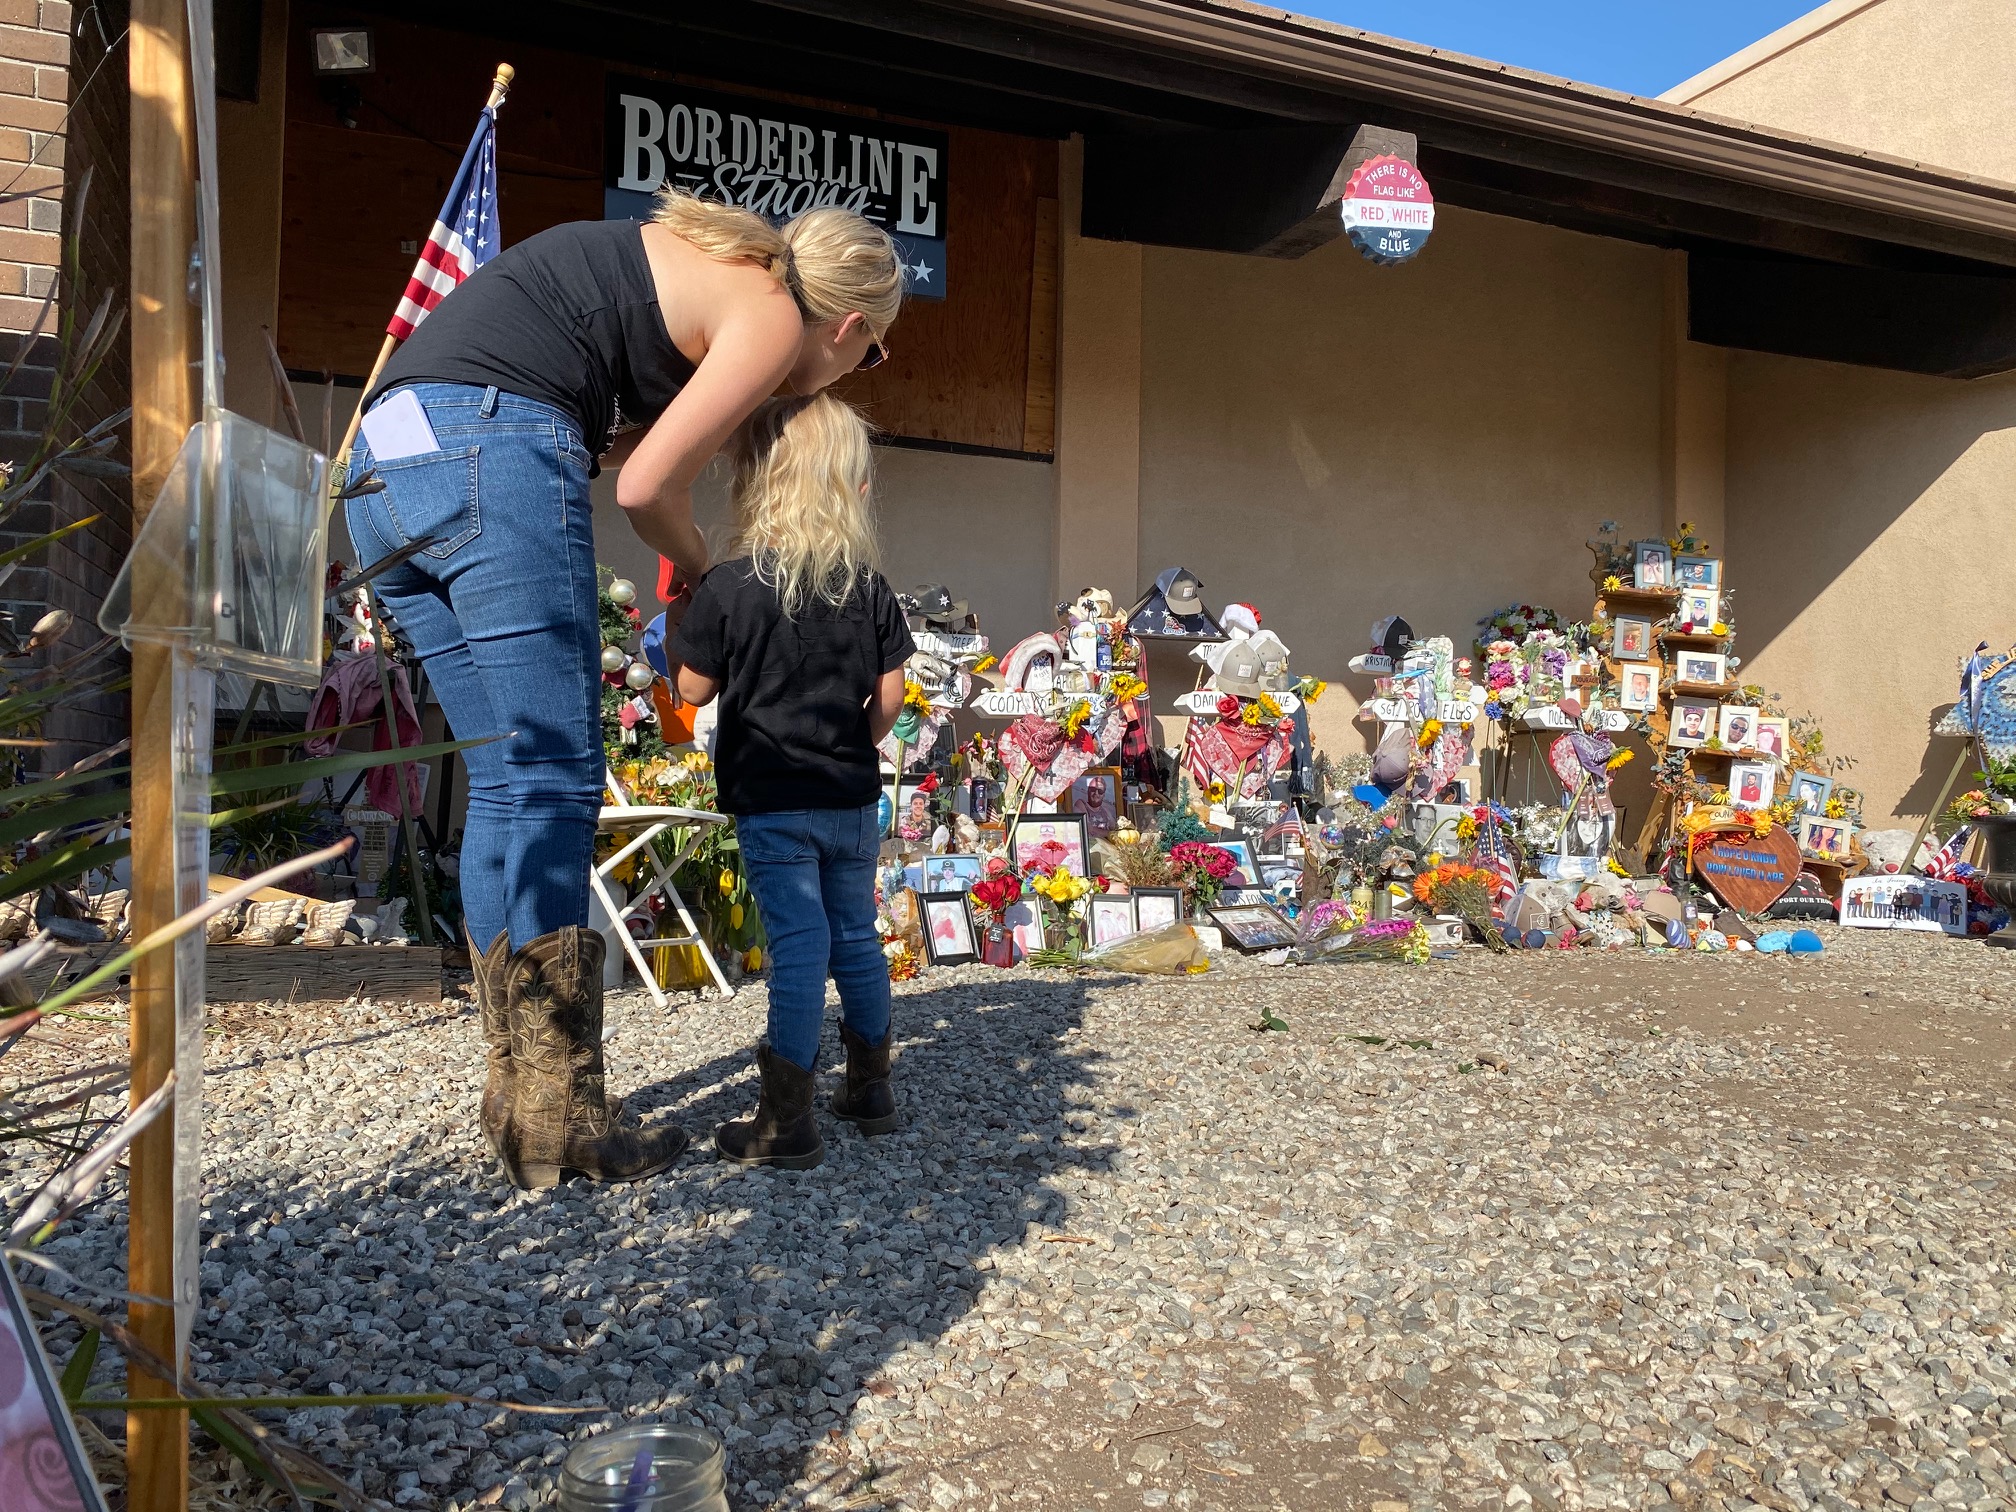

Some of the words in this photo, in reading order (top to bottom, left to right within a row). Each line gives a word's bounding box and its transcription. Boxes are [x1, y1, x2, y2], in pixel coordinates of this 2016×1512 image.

[618, 94, 937, 236] BORDERLINE
[1365, 164, 1395, 185] THERE
[1399, 166, 1408, 178] IS
[1409, 174, 1423, 190] NO
[1373, 185, 1395, 197] FLAG
[1396, 188, 1415, 198] LIKE
[1392, 208, 1428, 224] WHITE
[1388, 230, 1402, 239] AND
[1379, 237, 1411, 252] BLUE
[989, 694, 1021, 713] CODY
[1718, 847, 1741, 861] HOPE
[1751, 852, 1778, 865] KNOW
[1706, 862, 1728, 875] HOW
[1728, 865, 1757, 880] LOVED
[1766, 873, 1785, 883] ARE
[1799, 896, 1815, 904] OUR
